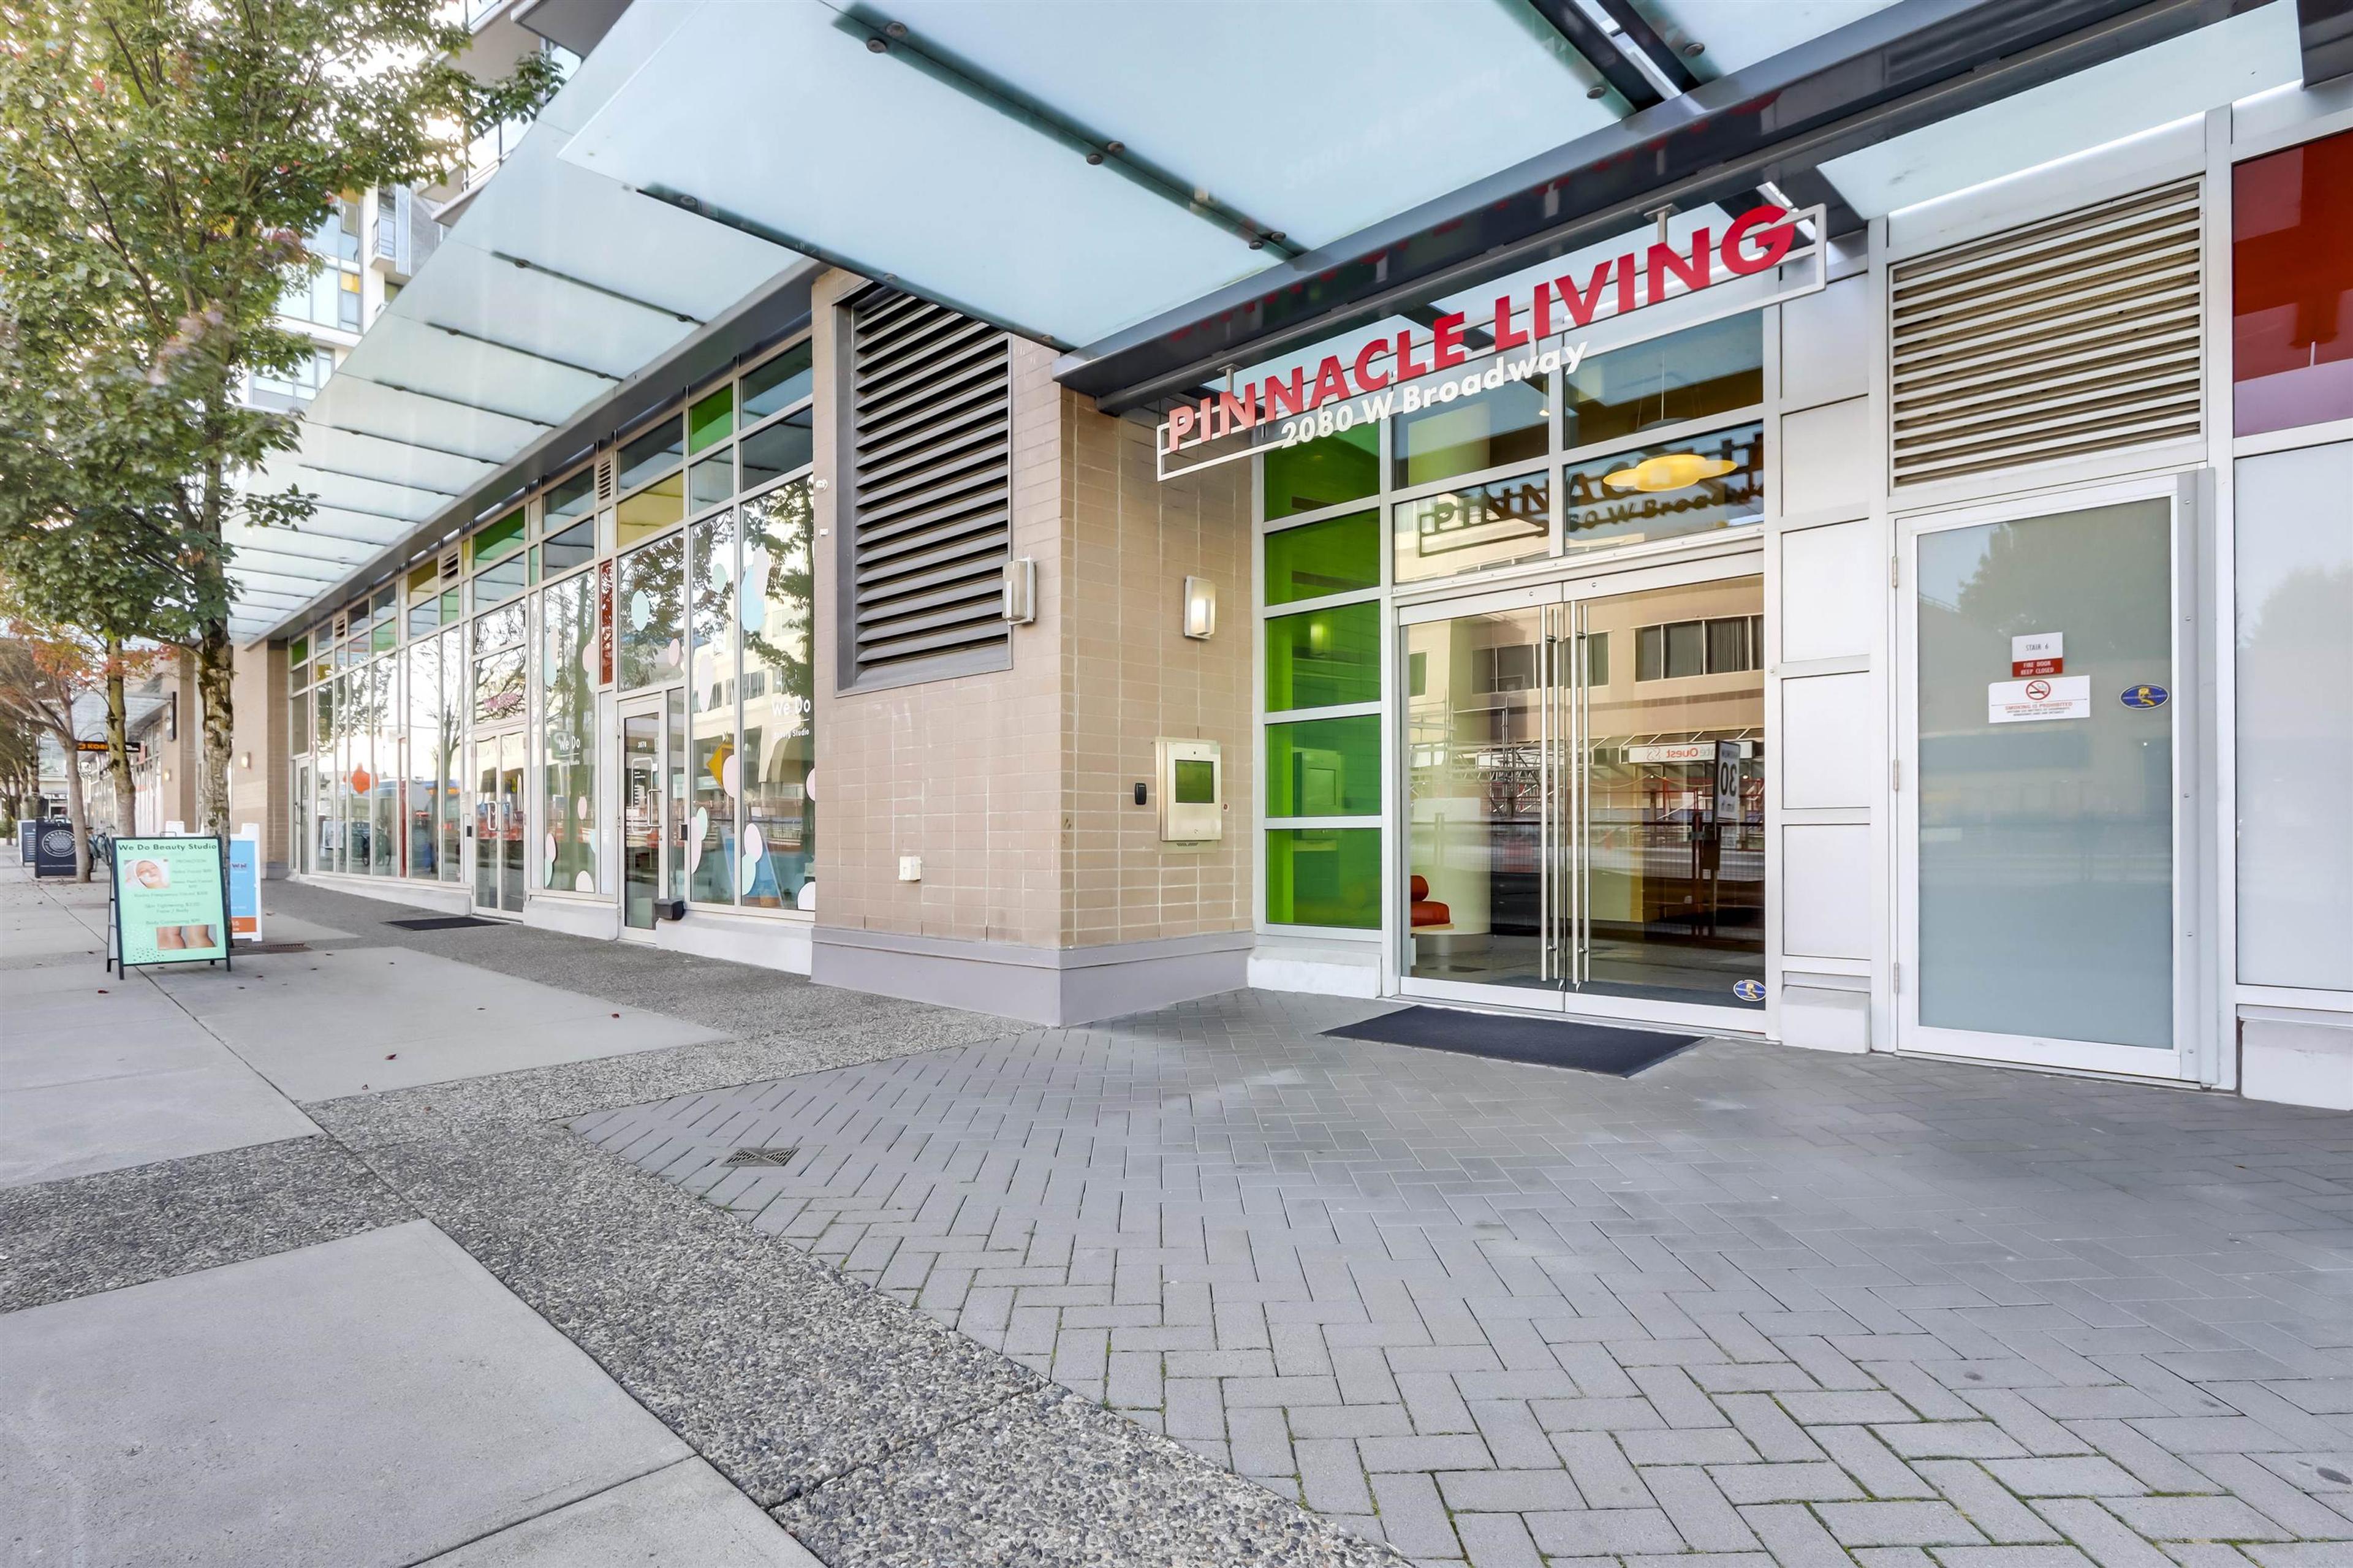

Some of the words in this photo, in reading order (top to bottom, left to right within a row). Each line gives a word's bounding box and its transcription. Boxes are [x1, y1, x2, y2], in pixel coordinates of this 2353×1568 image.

[1169, 311, 1466, 451] PINNACLE
[1495, 204, 1795, 352] LIVING
[1281, 405, 1353, 449] 2080
[1361, 390, 1395, 424] W
[1403, 341, 1588, 414] Broadway
[571, 735, 581, 749] Do
